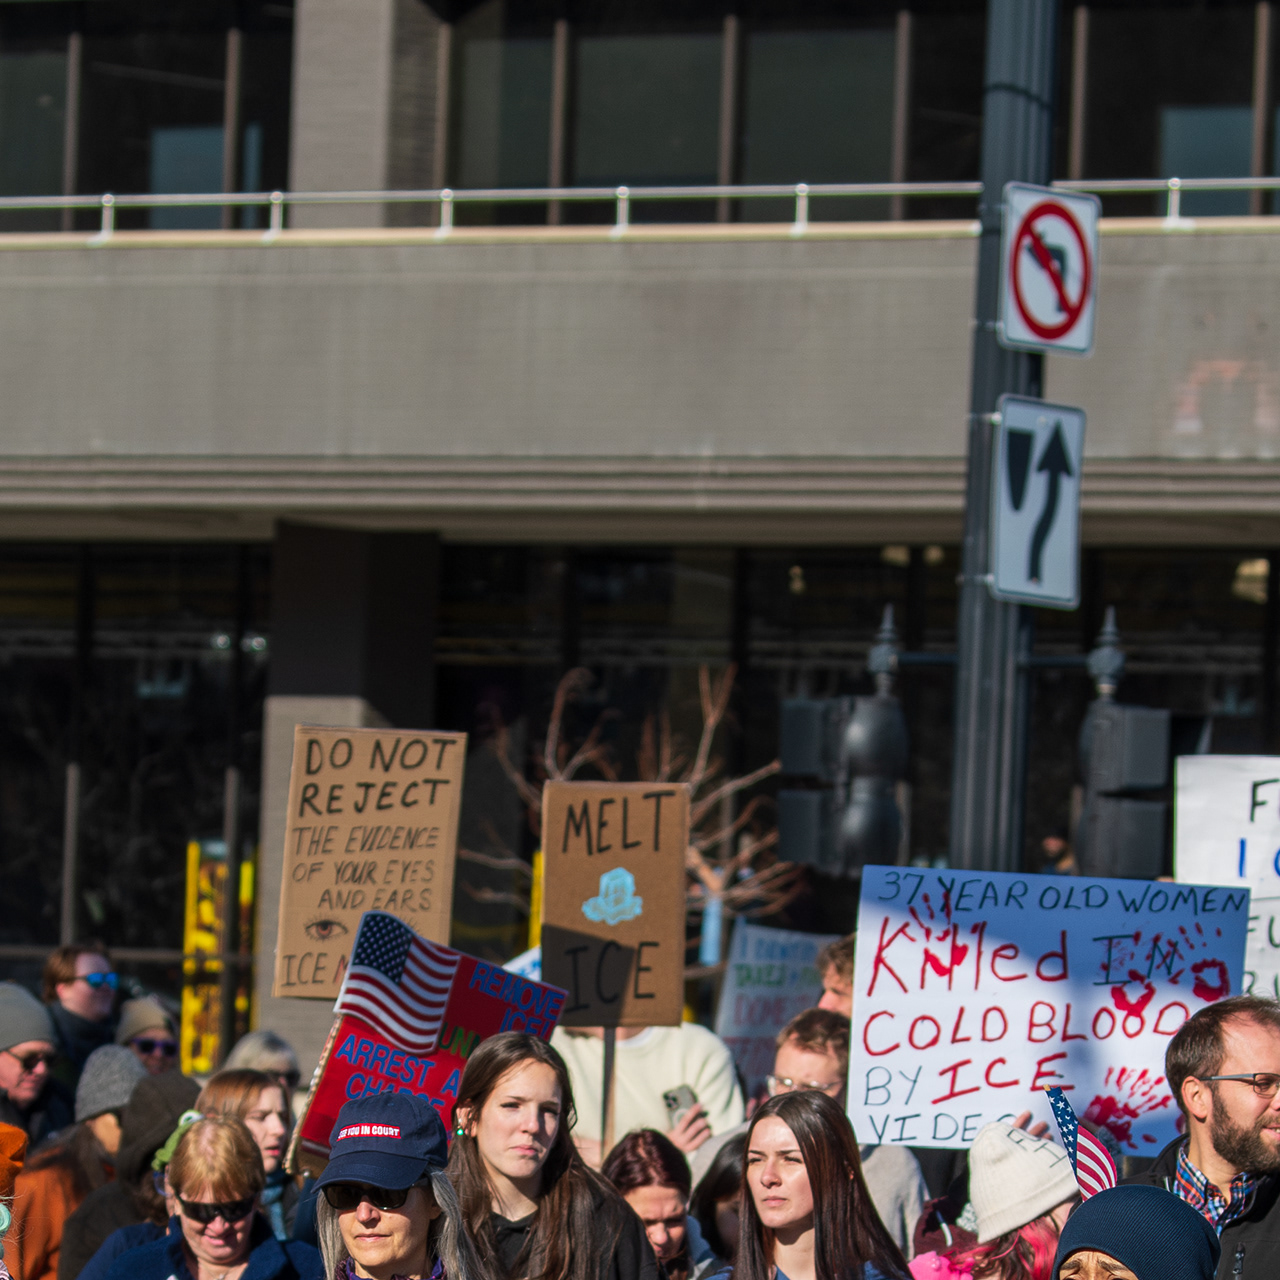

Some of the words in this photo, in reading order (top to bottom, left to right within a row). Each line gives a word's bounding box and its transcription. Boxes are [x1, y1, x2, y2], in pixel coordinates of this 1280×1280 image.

[305, 738, 354, 776] DO
[369, 738, 458, 773] NOT
[298, 779, 450, 818] REJECT
[293, 826, 338, 856] THE
[344, 826, 440, 853] EVIDENCE
[563, 790, 676, 856] MELT
[292, 861, 324, 884] OF
[334, 860, 377, 886] YOUR
[383, 859, 435, 884] EYES
[878, 870, 926, 906] 37
[938, 875, 1029, 914] YEAR
[1038, 884, 1109, 911] OLD
[1118, 886, 1249, 916] WOMEN
[317, 888, 363, 913] AND
[372, 888, 431, 912] EARS
[281, 952, 328, 987] ICE
[563, 941, 660, 1013] ICE
[866, 916, 1069, 997] Killed
[1091, 934, 1180, 986] IN
[469, 961, 565, 1022] REMOVE
[500, 1008, 553, 1038] ICE!
[863, 1004, 1010, 1056] COLD
[1027, 1000, 1191, 1044] BLOOD
[335, 1034, 436, 1088] ARREST
[864, 1064, 923, 1106] BY
[930, 1052, 1075, 1105] ICE
[347, 1126, 360, 1136] YOU
[361, 1125, 370, 1135] IN
[372, 1125, 400, 1137] COURT
